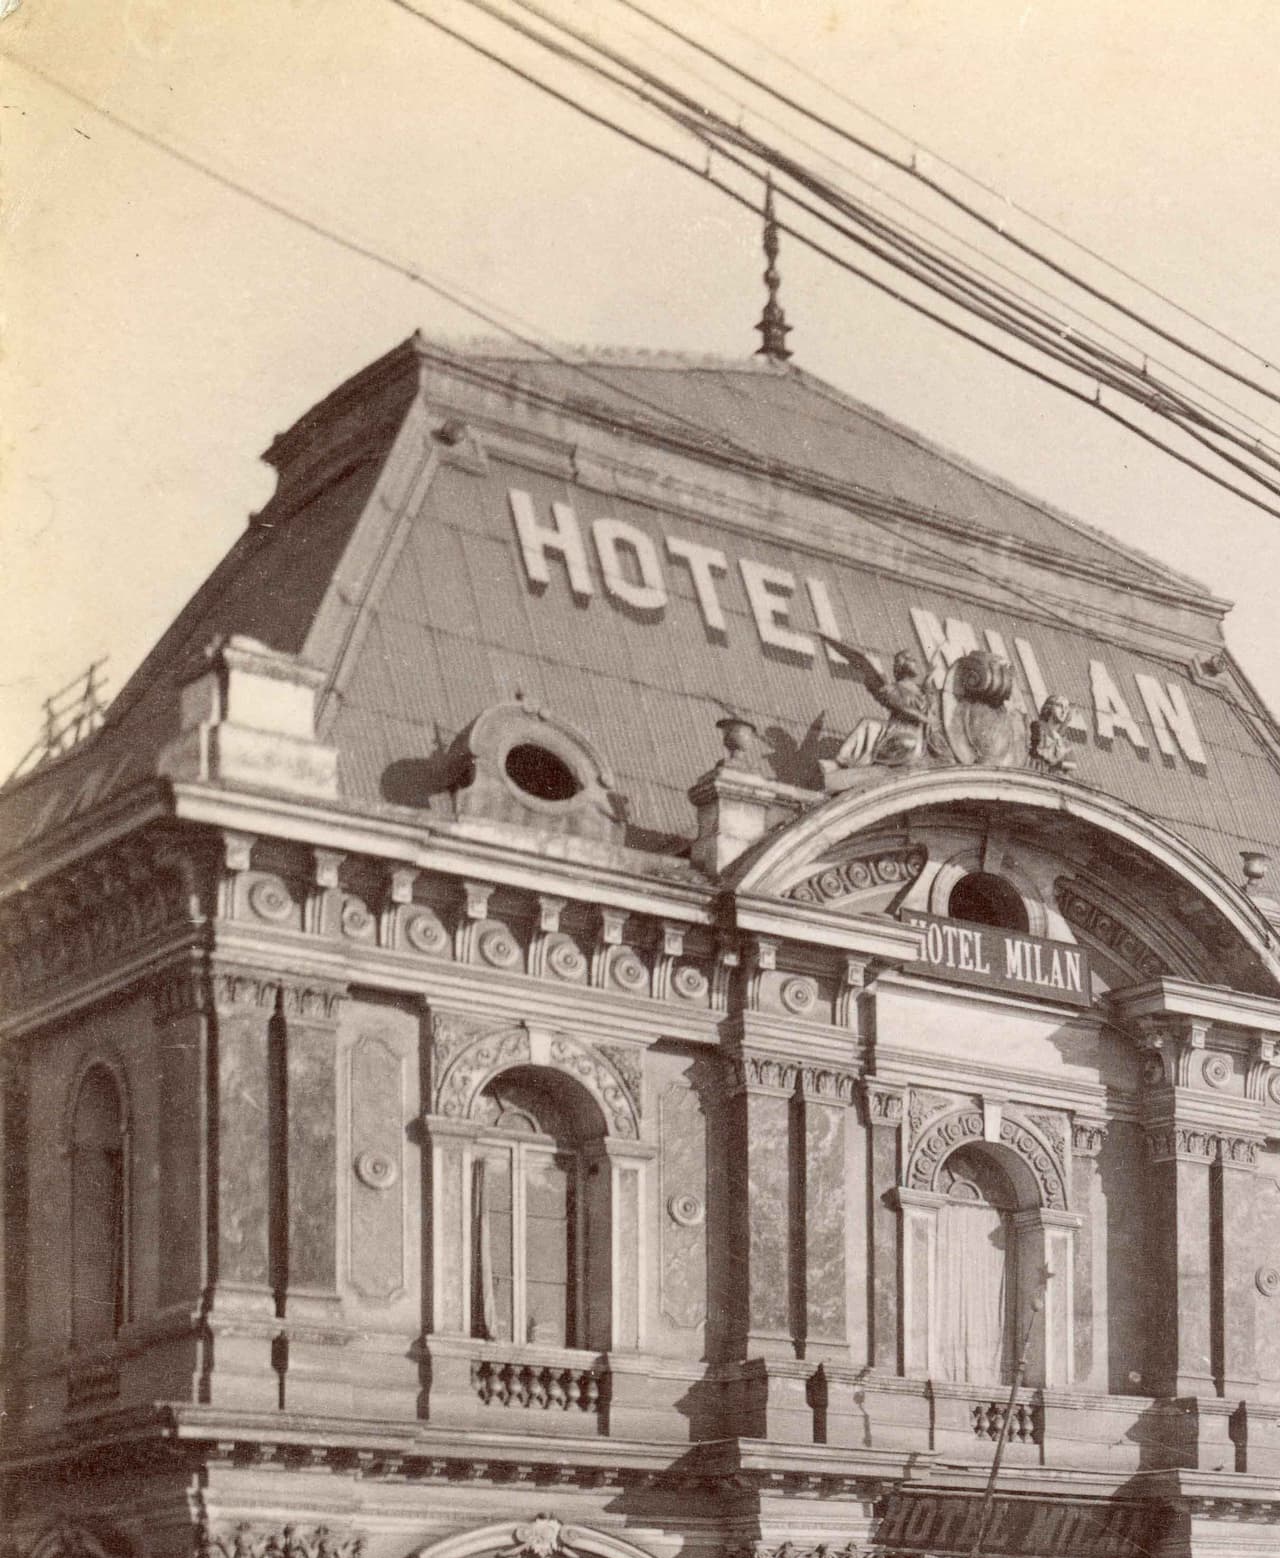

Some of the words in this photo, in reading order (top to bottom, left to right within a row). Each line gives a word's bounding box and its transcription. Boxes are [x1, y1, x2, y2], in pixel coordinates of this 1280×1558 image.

[507, 487, 886, 678] HOTEL
[910, 606, 1207, 764] MILAN
[1004, 938, 1083, 992] MILAN
[876, 1497, 1011, 1548] HOTEL
